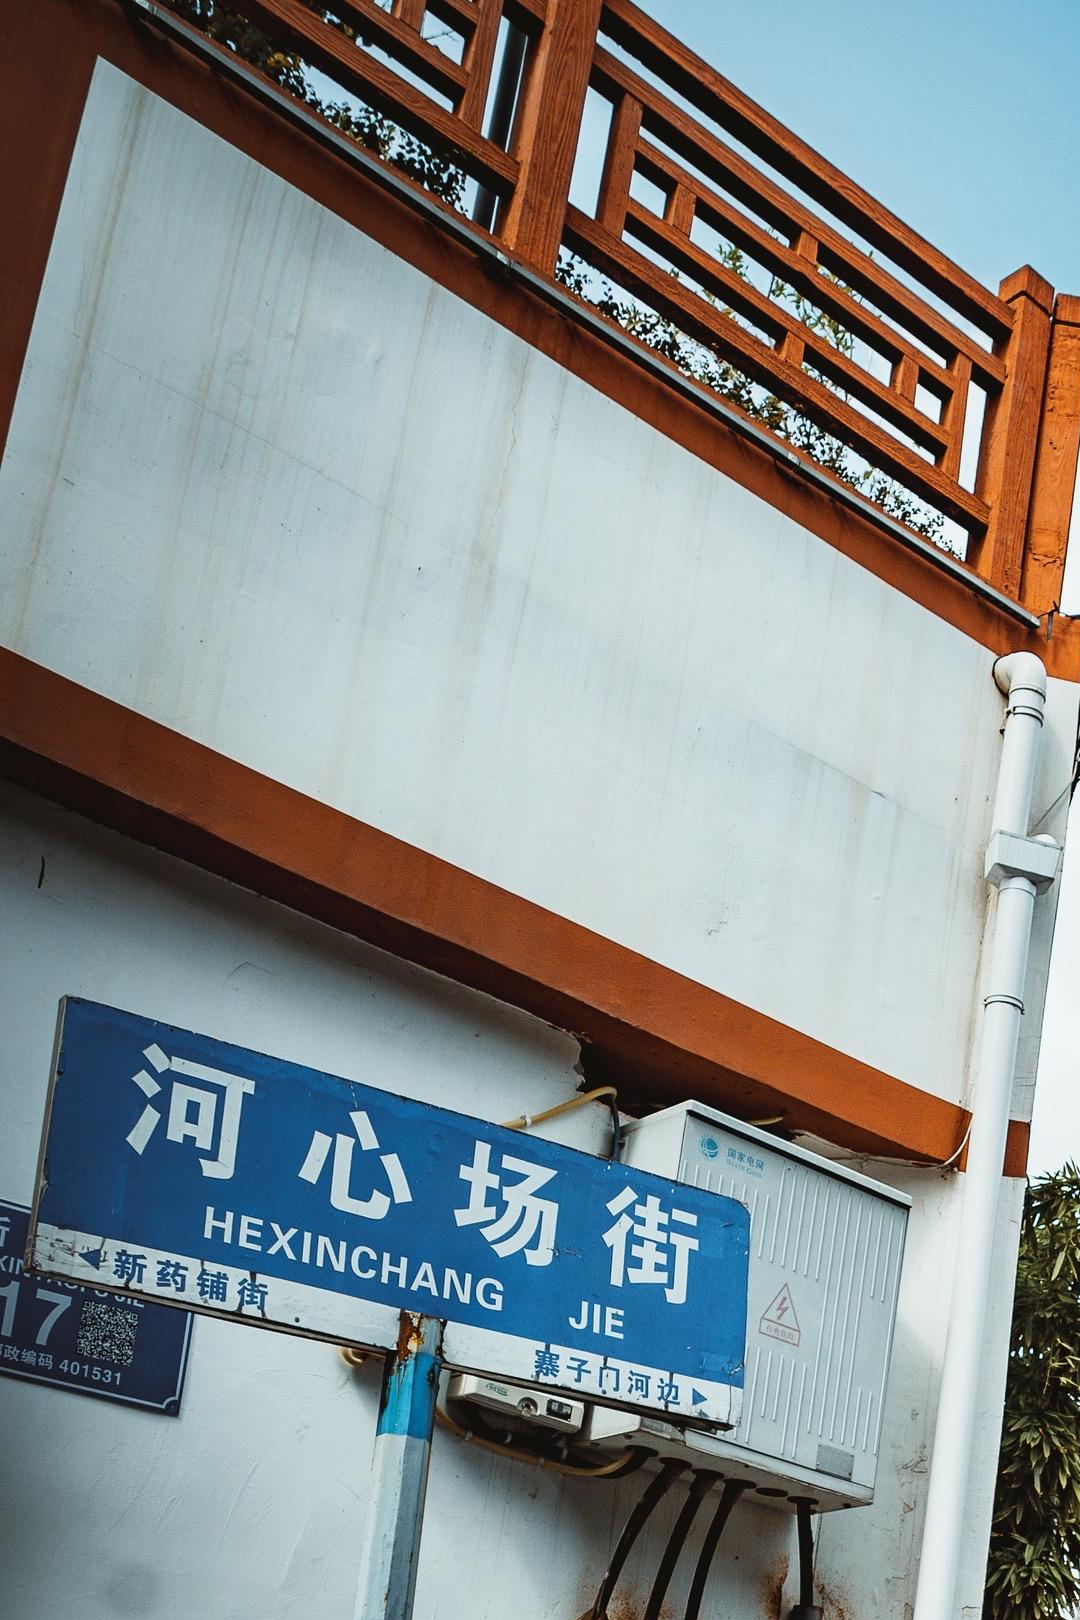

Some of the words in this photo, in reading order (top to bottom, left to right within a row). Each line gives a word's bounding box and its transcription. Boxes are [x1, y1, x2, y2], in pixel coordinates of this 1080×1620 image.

[126, 1043, 699, 1305] 河心场街
[727, 1147, 764, 1170] 国家电网
[112, 1249, 268, 1310] 新药铺街
[203, 1205, 504, 1311] HEXINCHANG
[568, 1301, 625, 1339] JIE
[0, 1343, 53, 1370] 政编码
[59, 1360, 121, 1386] 401531
[534, 1350, 681, 1405] 寨子门河边
